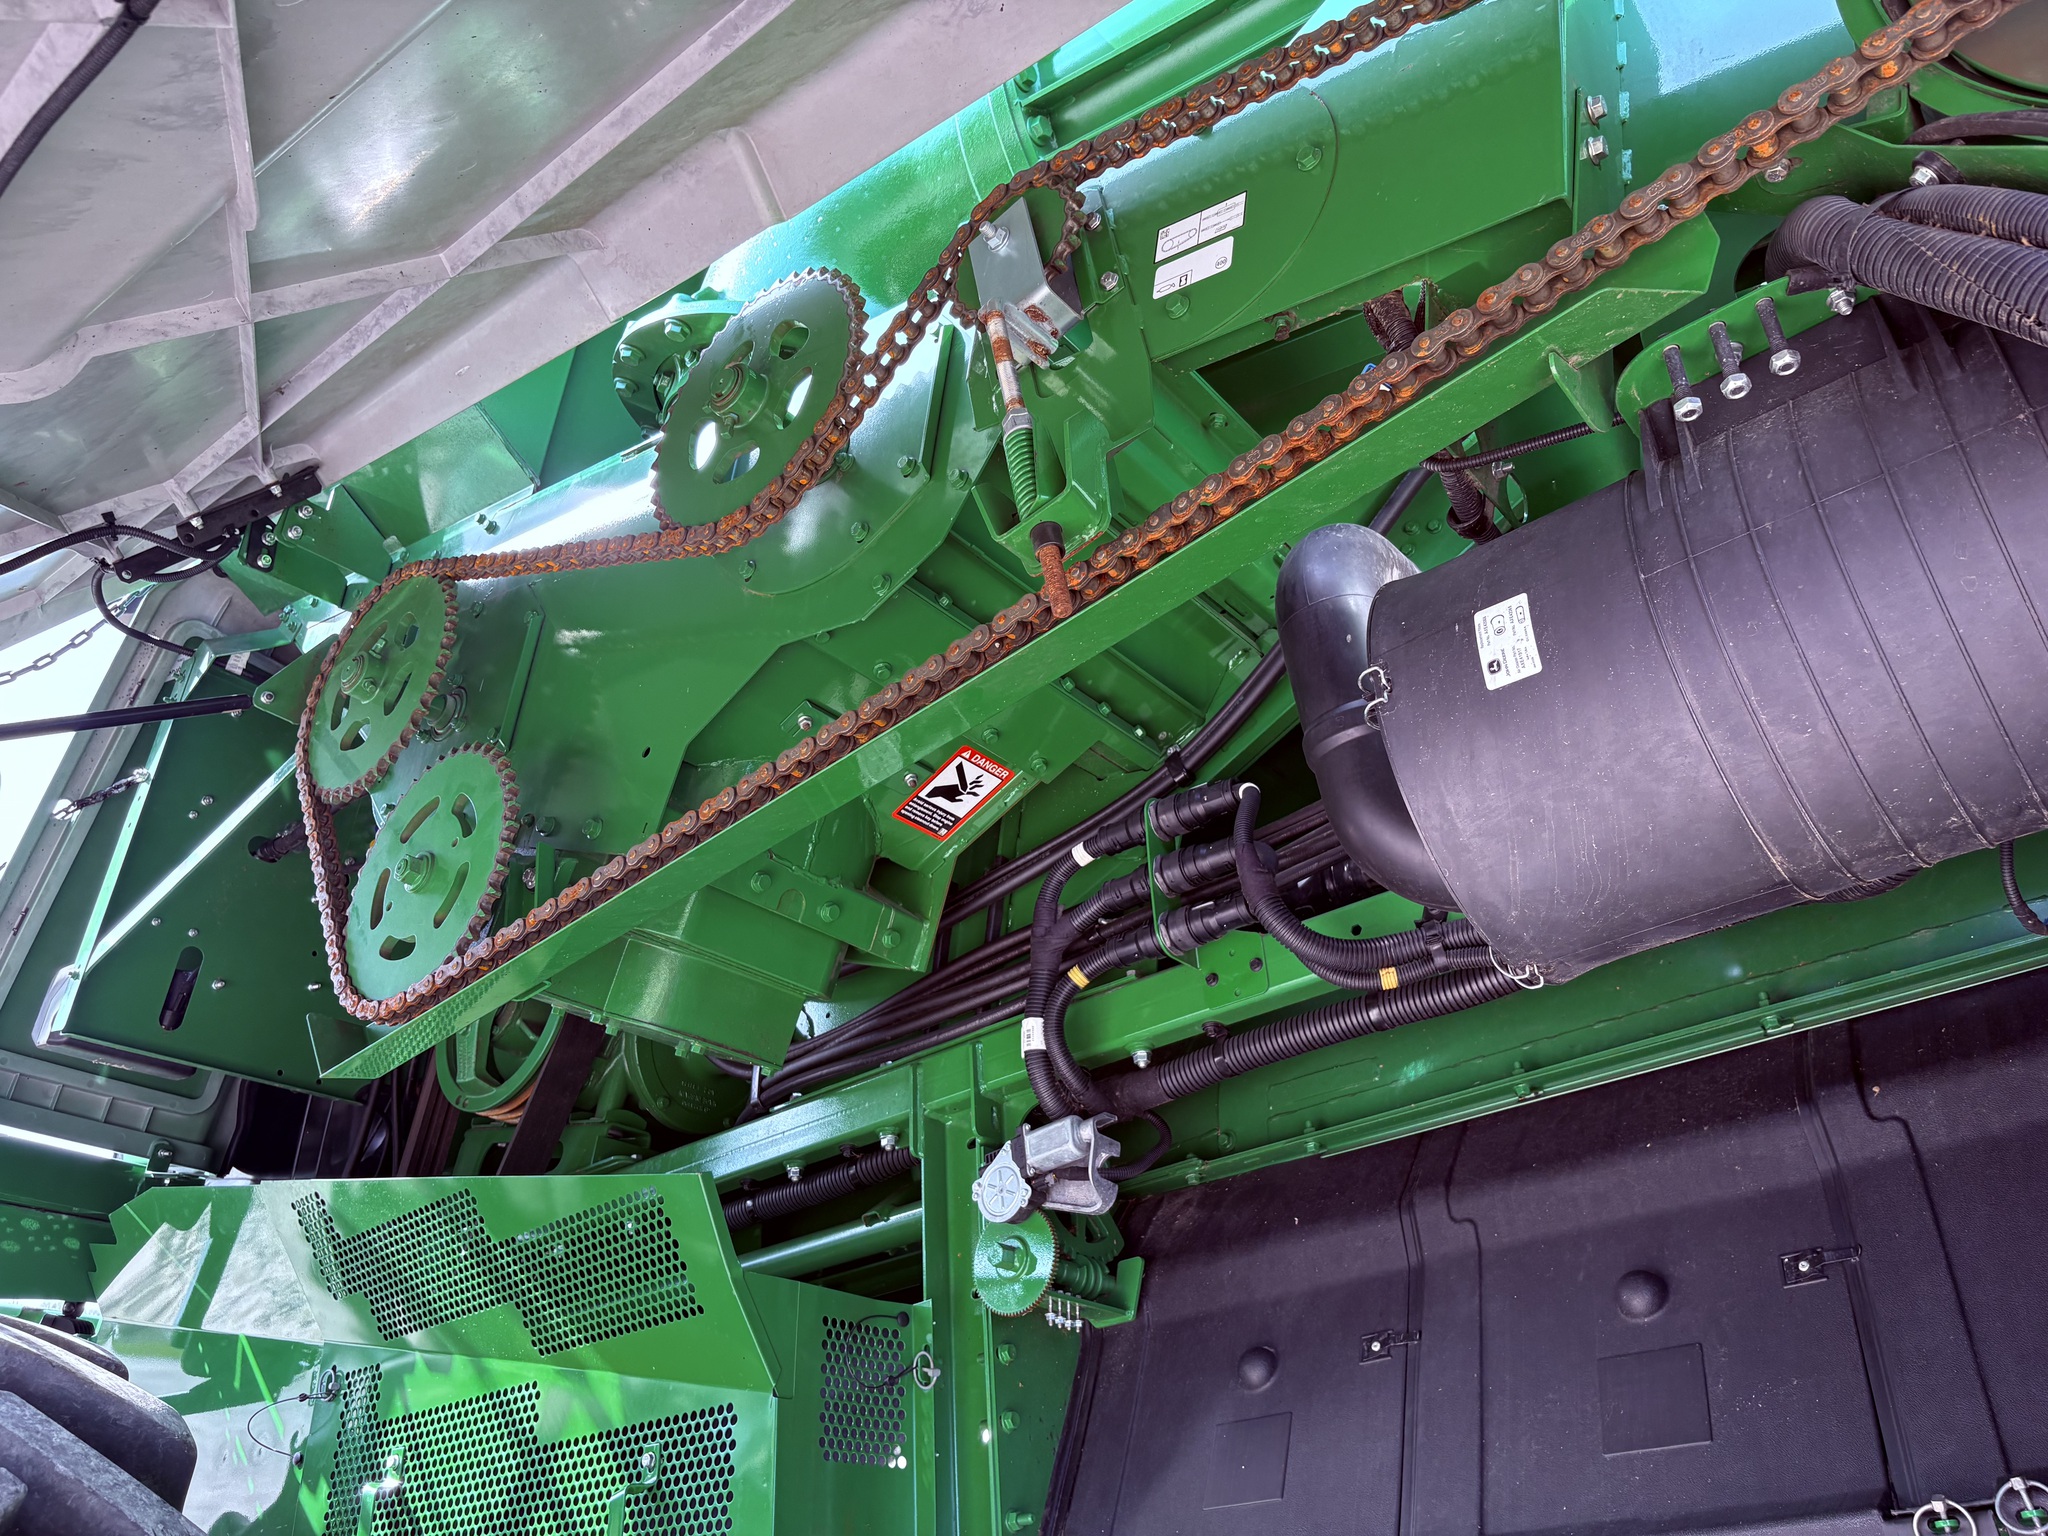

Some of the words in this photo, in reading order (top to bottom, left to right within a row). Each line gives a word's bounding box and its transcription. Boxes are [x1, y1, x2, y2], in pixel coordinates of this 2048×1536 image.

[971, 754, 1010, 780] DANGER
[900, 809, 915, 820] opening
[908, 801, 933, 816] entanglement.
[941, 818, 953, 826] engine
[913, 797, 924, 805] Avoid
[923, 803, 936, 812] serious
[936, 809, 947, 817] injury
[912, 809, 925, 817] remove
[931, 818, 943, 827] before
